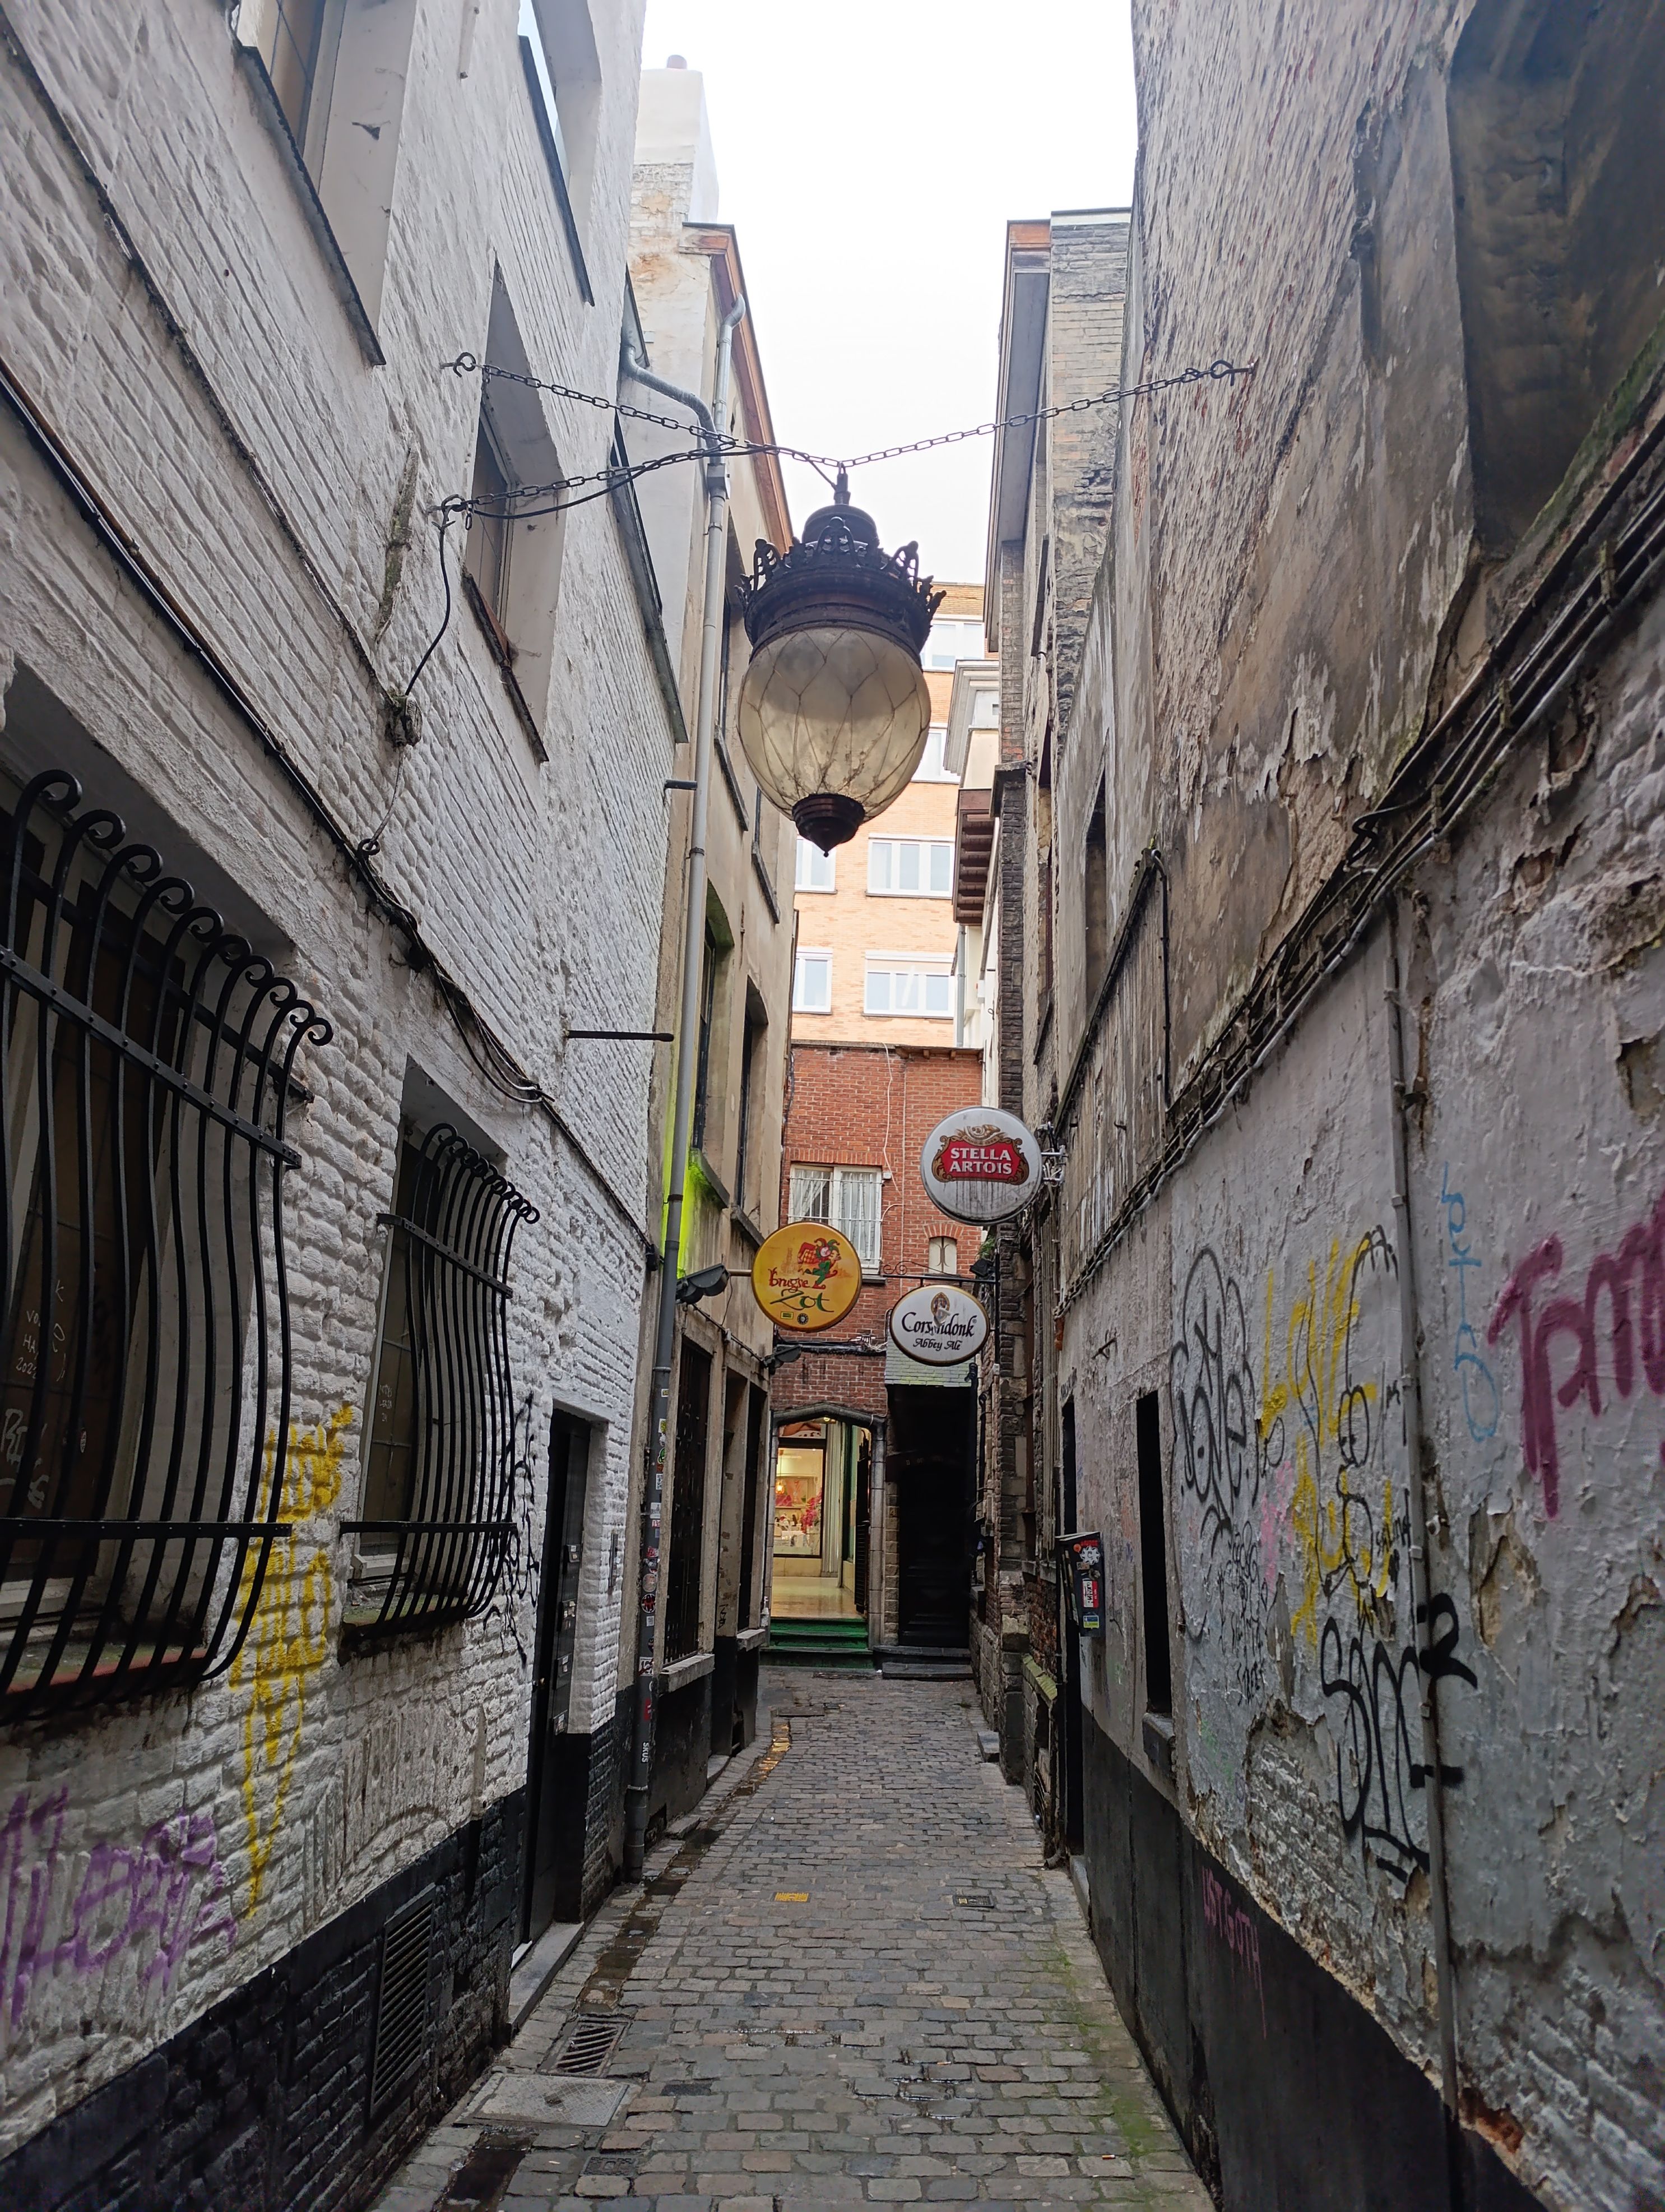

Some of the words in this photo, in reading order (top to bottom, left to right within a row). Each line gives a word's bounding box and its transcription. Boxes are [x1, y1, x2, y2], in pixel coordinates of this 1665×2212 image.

[950, 1147, 1012, 1161] STELLA
[949, 1161, 1012, 1174] ARTOIS
[770, 1289, 834, 1313] Zot
[913, 1338, 943, 1352] Abbey
[944, 1340, 963, 1350] Ale
